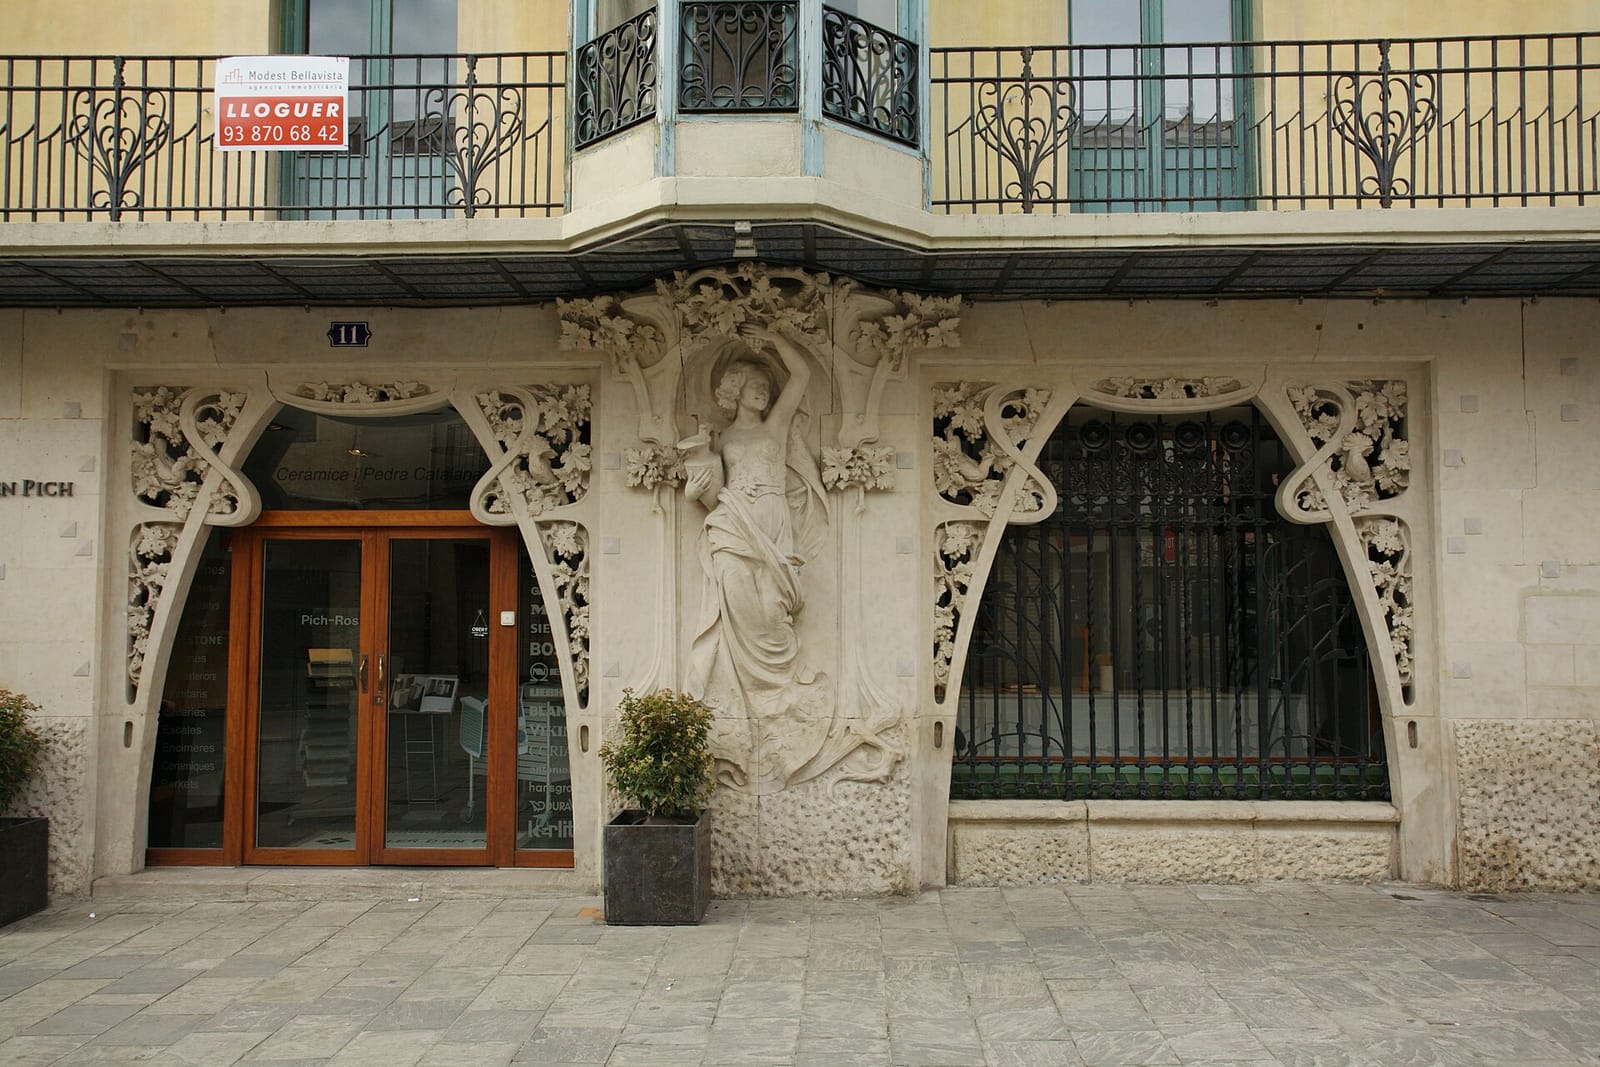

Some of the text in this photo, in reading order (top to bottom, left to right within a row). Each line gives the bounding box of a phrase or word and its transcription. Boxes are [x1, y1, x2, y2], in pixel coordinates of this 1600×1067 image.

[248, 70, 343, 81] Modest Bellavista
[226, 102, 340, 118] LLOGUER
[224, 125, 339, 142] 93 870 68 42
[338, 325, 357, 344] 11
[363, 467, 408, 481] Pedra
[0, 481, 16, 496] N
[301, 614, 359, 626] Pich-Ros
